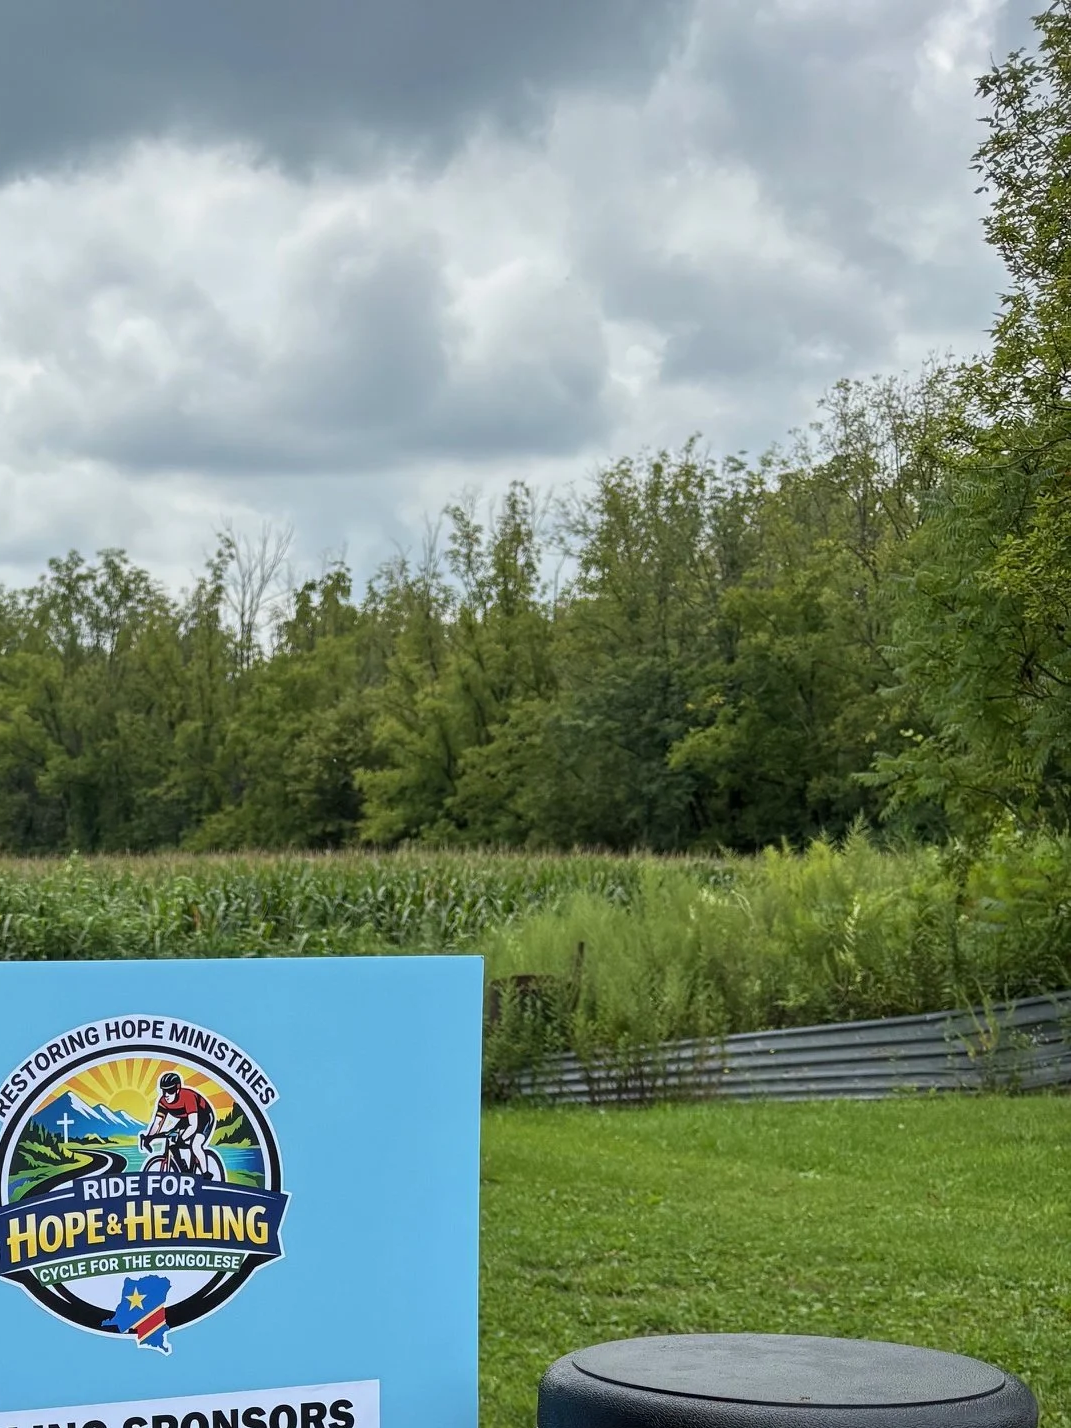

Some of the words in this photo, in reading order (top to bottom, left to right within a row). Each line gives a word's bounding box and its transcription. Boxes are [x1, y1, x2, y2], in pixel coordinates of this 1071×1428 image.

[106, 1020, 165, 1041] HOPE
[169, 1023, 275, 1105] MINISTRIES
[83, 1177, 140, 1200] RIDE
[147, 1176, 195, 1197] FOR
[39, 1265, 87, 1283] CYCLE
[91, 1258, 119, 1272] FOR
[123, 1256, 151, 1268] THE
[155, 1253, 240, 1269] CONGOLESE
